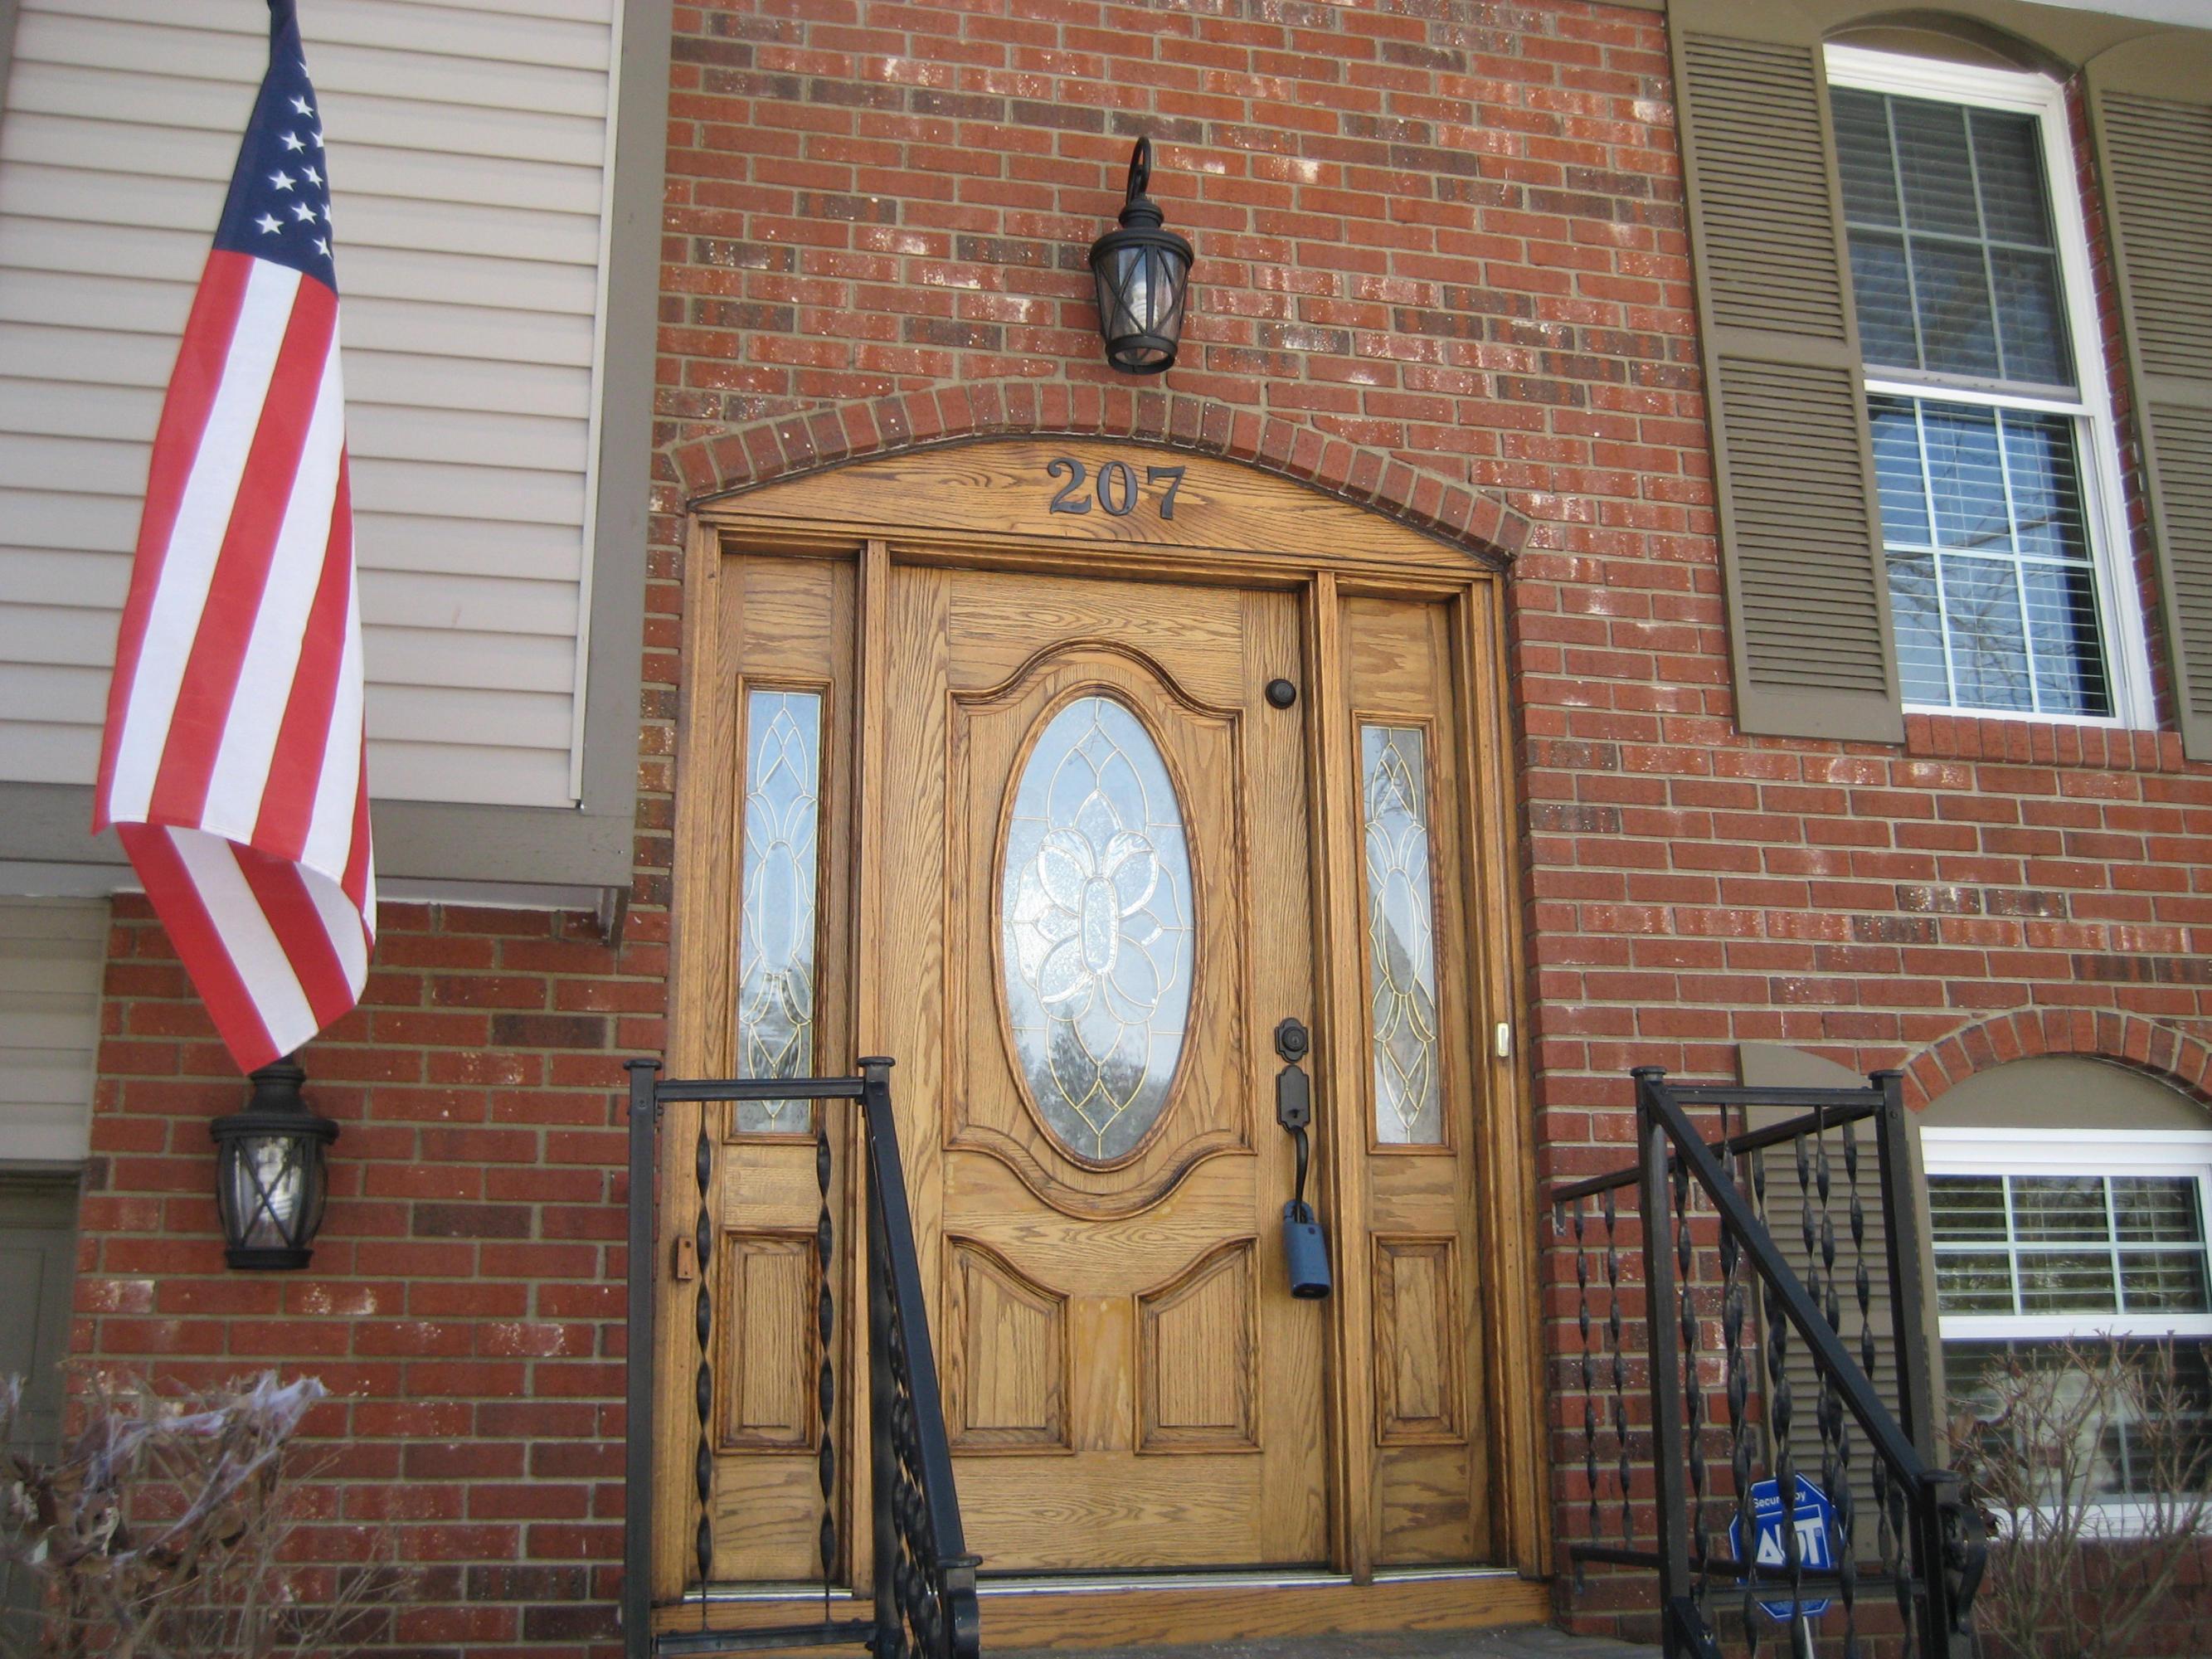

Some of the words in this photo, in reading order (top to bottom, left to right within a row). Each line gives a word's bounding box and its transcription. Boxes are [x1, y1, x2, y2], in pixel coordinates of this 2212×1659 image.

[1048, 457, 1186, 520] 207
[1753, 1495, 1790, 1508] Secur
[1756, 1516, 1823, 1565] ADT
